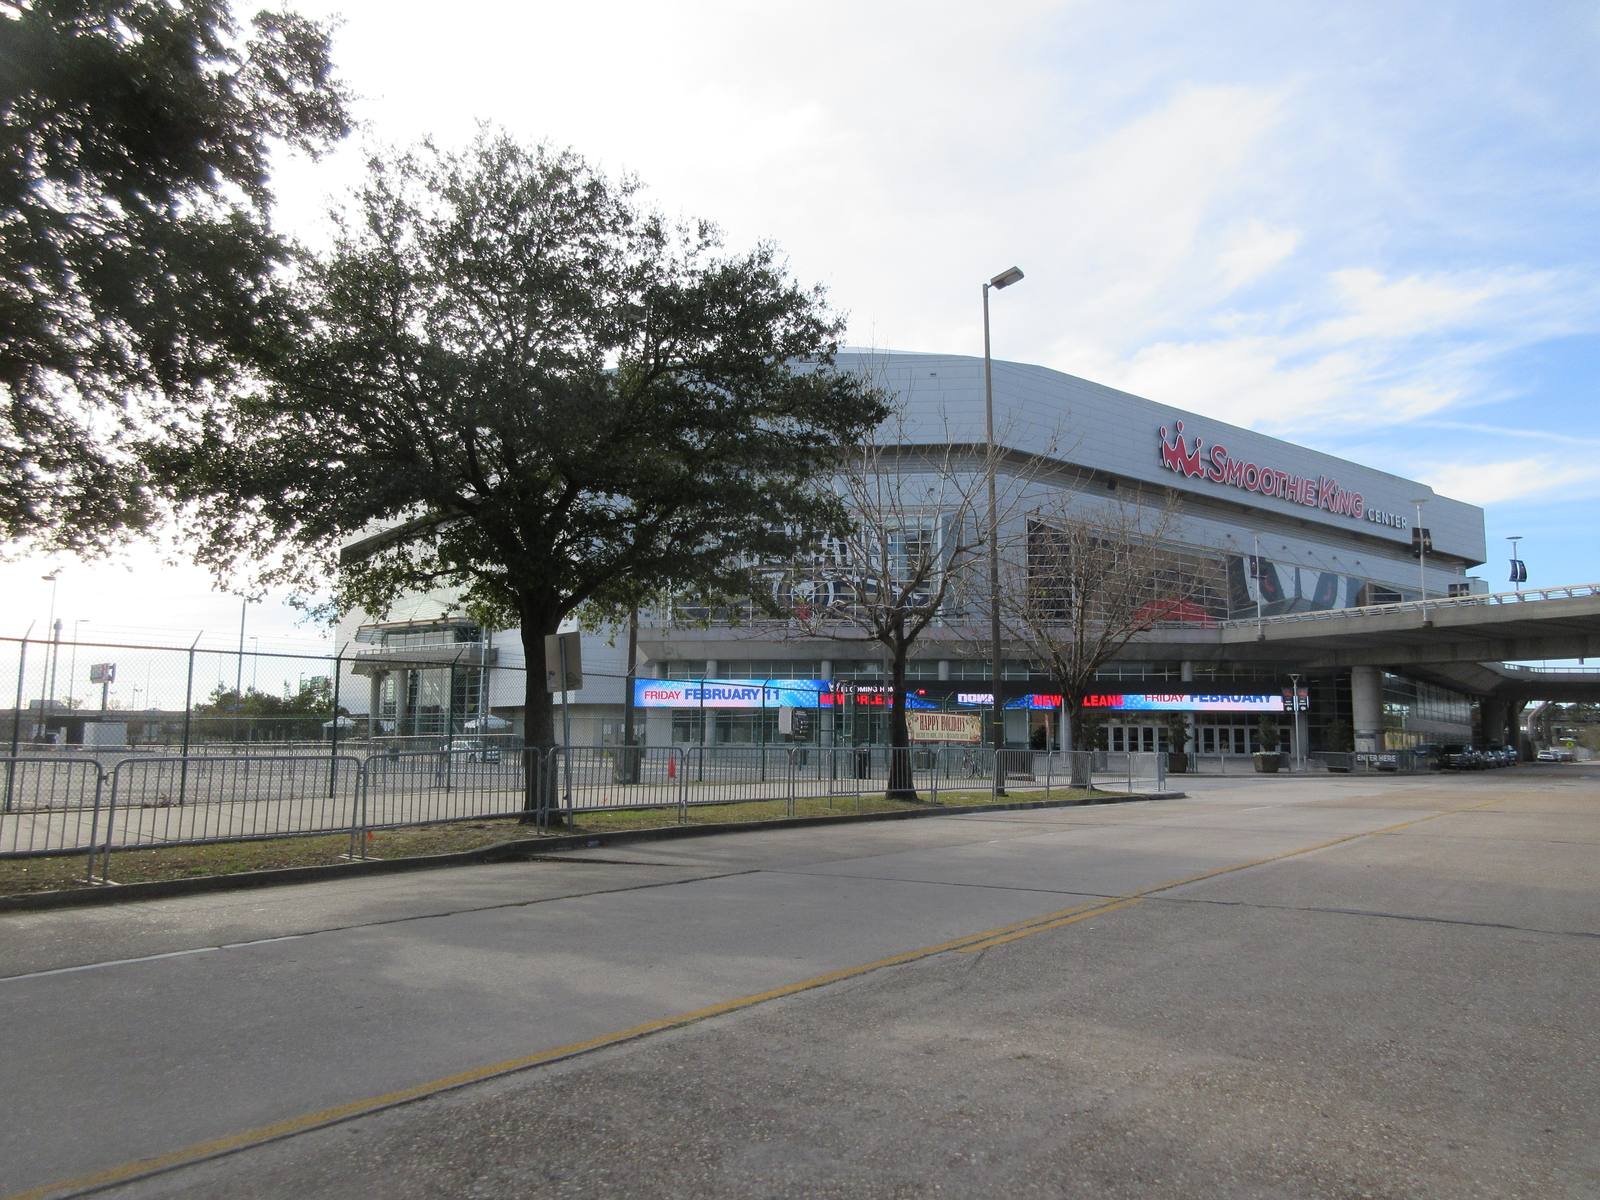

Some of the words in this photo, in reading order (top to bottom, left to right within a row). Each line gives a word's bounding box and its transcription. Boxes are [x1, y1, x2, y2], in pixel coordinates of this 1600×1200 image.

[1208, 444, 1316, 507] SMOOTHIE
[1318, 475, 1364, 519] KING
[1367, 508, 1407, 529] CENTER
[644, 690, 681, 700] FRIDAY
[684, 688, 760, 700] FEBRUARY
[765, 689, 780, 700] 11
[1033, 694, 1062, 707] NEW
[1081, 694, 1124, 707] LEANS
[1145, 695, 1185, 703] FRIDAY
[1189, 695, 1271, 704] FEBRUARY
[919, 714, 940, 731] HAPPY
